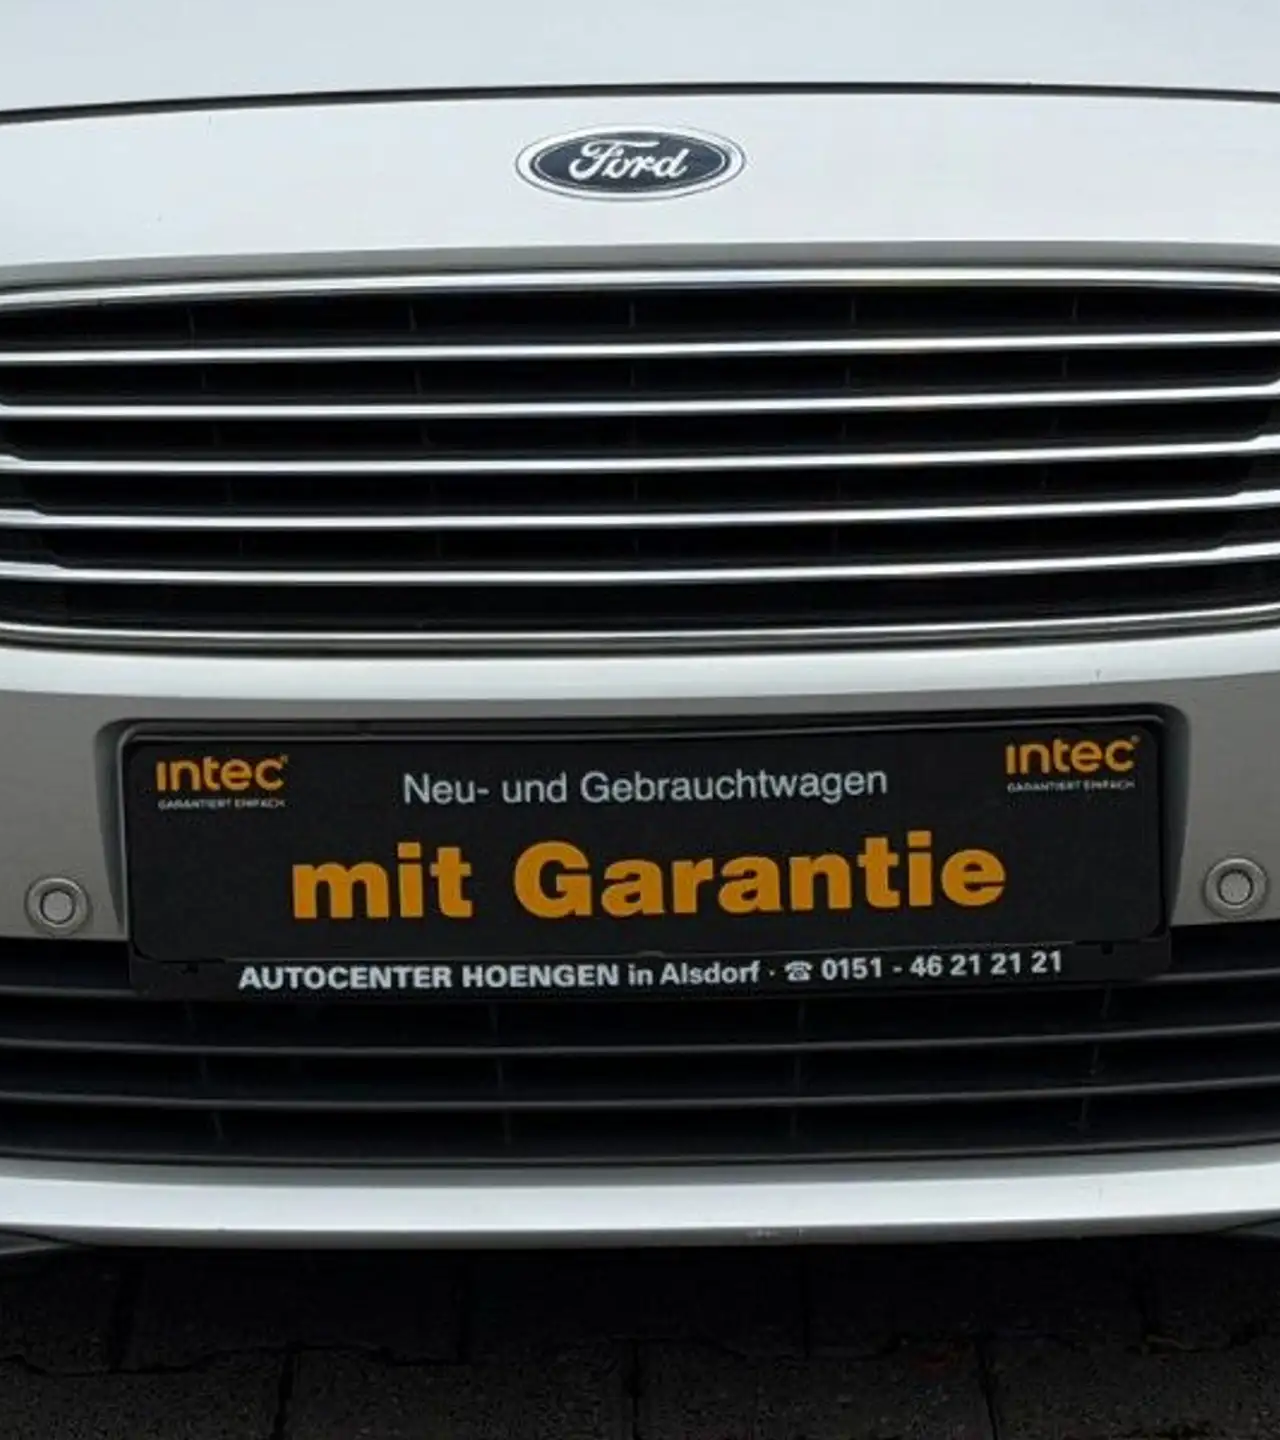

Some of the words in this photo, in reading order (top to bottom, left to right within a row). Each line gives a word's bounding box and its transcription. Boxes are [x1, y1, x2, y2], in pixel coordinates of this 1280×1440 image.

[569, 139, 690, 181] Ford
[156, 755, 285, 792] intec
[1005, 738, 1135, 775] intec
[404, 773, 490, 805] Neu-
[503, 771, 568, 803] und
[580, 768, 888, 805] Gebrauchtwagen
[292, 841, 473, 919] mit
[513, 830, 1007, 919] Garantie
[237, 965, 453, 990] AUTOCENTER
[462, 963, 619, 988] HOENGEN
[627, 963, 654, 986] in
[659, 960, 761, 985] Alsdorf
[821, 957, 882, 981] 0151
[909, 954, 943, 977] 46
[950, 953, 981, 976] 21
[990, 952, 1022, 975] 21
[1030, 950, 1062, 974] 21
